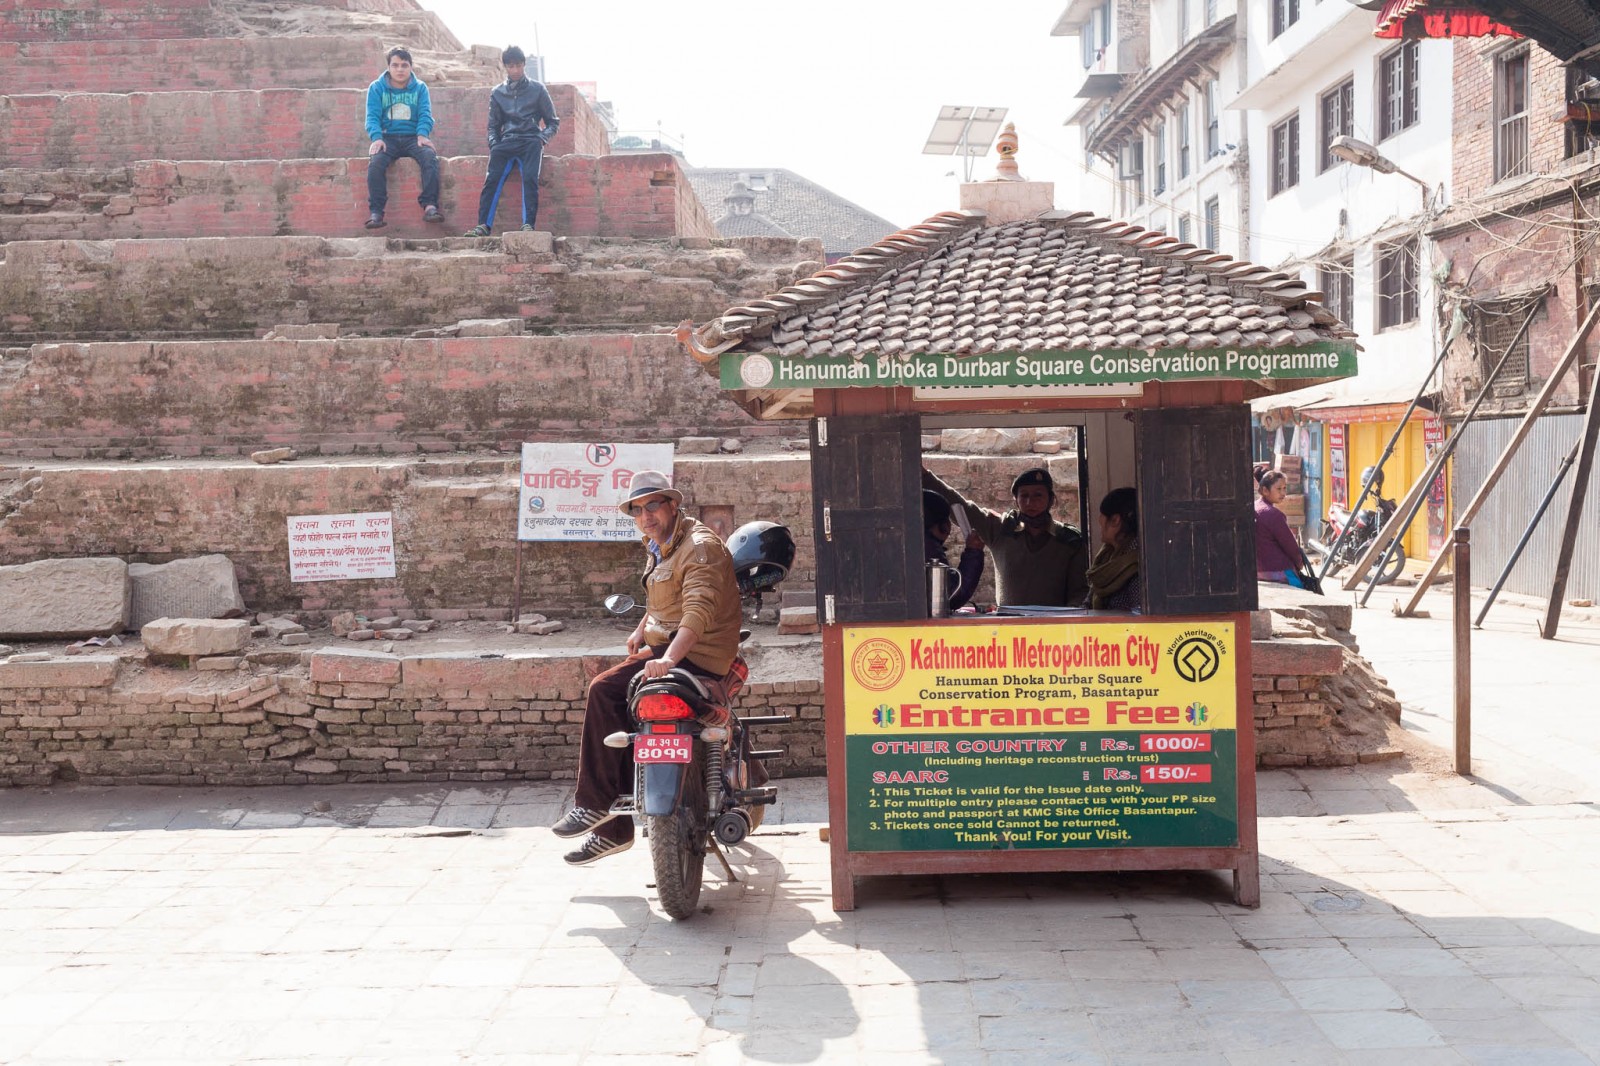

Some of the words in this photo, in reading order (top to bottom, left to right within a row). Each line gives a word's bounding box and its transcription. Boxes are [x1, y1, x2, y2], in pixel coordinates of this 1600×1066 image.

[779, 360, 870, 380] Hanuman
[877, 358, 938, 379] Dhoka
[944, 357, 1010, 377] Durbar
[1016, 356, 1084, 380] Square
[1090, 352, 1219, 374] Conservation
[1226, 350, 1339, 375] Programme
[1166, 635, 1184, 655] World
[1184, 629, 1217, 641] Heritage
[1217, 640, 1227, 655] Site
[911, 637, 1006, 670] Kathmandu
[1013, 636, 1121, 675] Metropolitan
[1126, 635, 1160, 675] City
[936, 676, 998, 686] Hanuman
[1003, 675, 1044, 686] Dhoka
[1049, 674, 1093, 685] Durbar
[1097, 673, 1142, 687] Square
[919, 688, 1010, 700] Conservation
[1015, 688, 1077, 701] Program,
[1082, 687, 1159, 700] Basantapur
[900, 704, 1090, 728] Entrance
[1106, 701, 1179, 724] Fee
[872, 741, 950, 754] OTHER
[956, 739, 1067, 753] COUNTRY
[1100, 738, 1135, 751] Rs.
[1144, 737, 1205, 750] 1000/-
[925, 756, 982, 767] (Including
[985, 756, 1034, 766] heritage
[1037, 754, 1123, 764] reconstruction
[1127, 753, 1159, 763] trust)
[872, 770, 949, 784] SAARC
[1104, 768, 1138, 780] Rs.
[1145, 767, 1197, 779] 150/-
[884, 787, 911, 796] This
[914, 787, 953, 796] Ticket
[956, 787, 967, 795] is
[971, 786, 1000, 795] valid
[1003, 786, 1020, 795] for
[1024, 786, 1044, 794] the
[1085, 785, 1112, 793] date
[1116, 784, 1145, 794] only.
[869, 800, 880, 808] 2.
[884, 799, 904, 807] For
[907, 799, 957, 808] multiple
[961, 799, 993, 808] entry
[997, 798, 1038, 808] please
[1041, 797, 1089, 805] contact
[1110, 795, 1138, 804] with
[1141, 797, 1171, 806] your
[1172, 795, 1188, 803] PP
[1192, 795, 1216, 803] size
[884, 810, 919, 820] photo
[923, 810, 945, 818] and
[949, 809, 1003, 819] passport
[1007, 809, 1019, 817] at
[1023, 808, 1051, 816] KMC
[1055, 807, 1080, 816] Site
[1083, 807, 1120, 815] Office
[1123, 806, 1197, 817] Basantapur.
[869, 822, 880, 830] 3.
[884, 821, 930, 830] Tickets
[967, 820, 993, 829] sold
[996, 819, 1040, 829] Cannot
[1044, 819, 1059, 827] be
[1062, 818, 1120, 827] returned.
[954, 832, 998, 842] Thank
[1001, 831, 1032, 841] You!
[1036, 831, 1057, 840] For
[1061, 831, 1092, 843] your
[1095, 830, 1132, 840] Visit.
